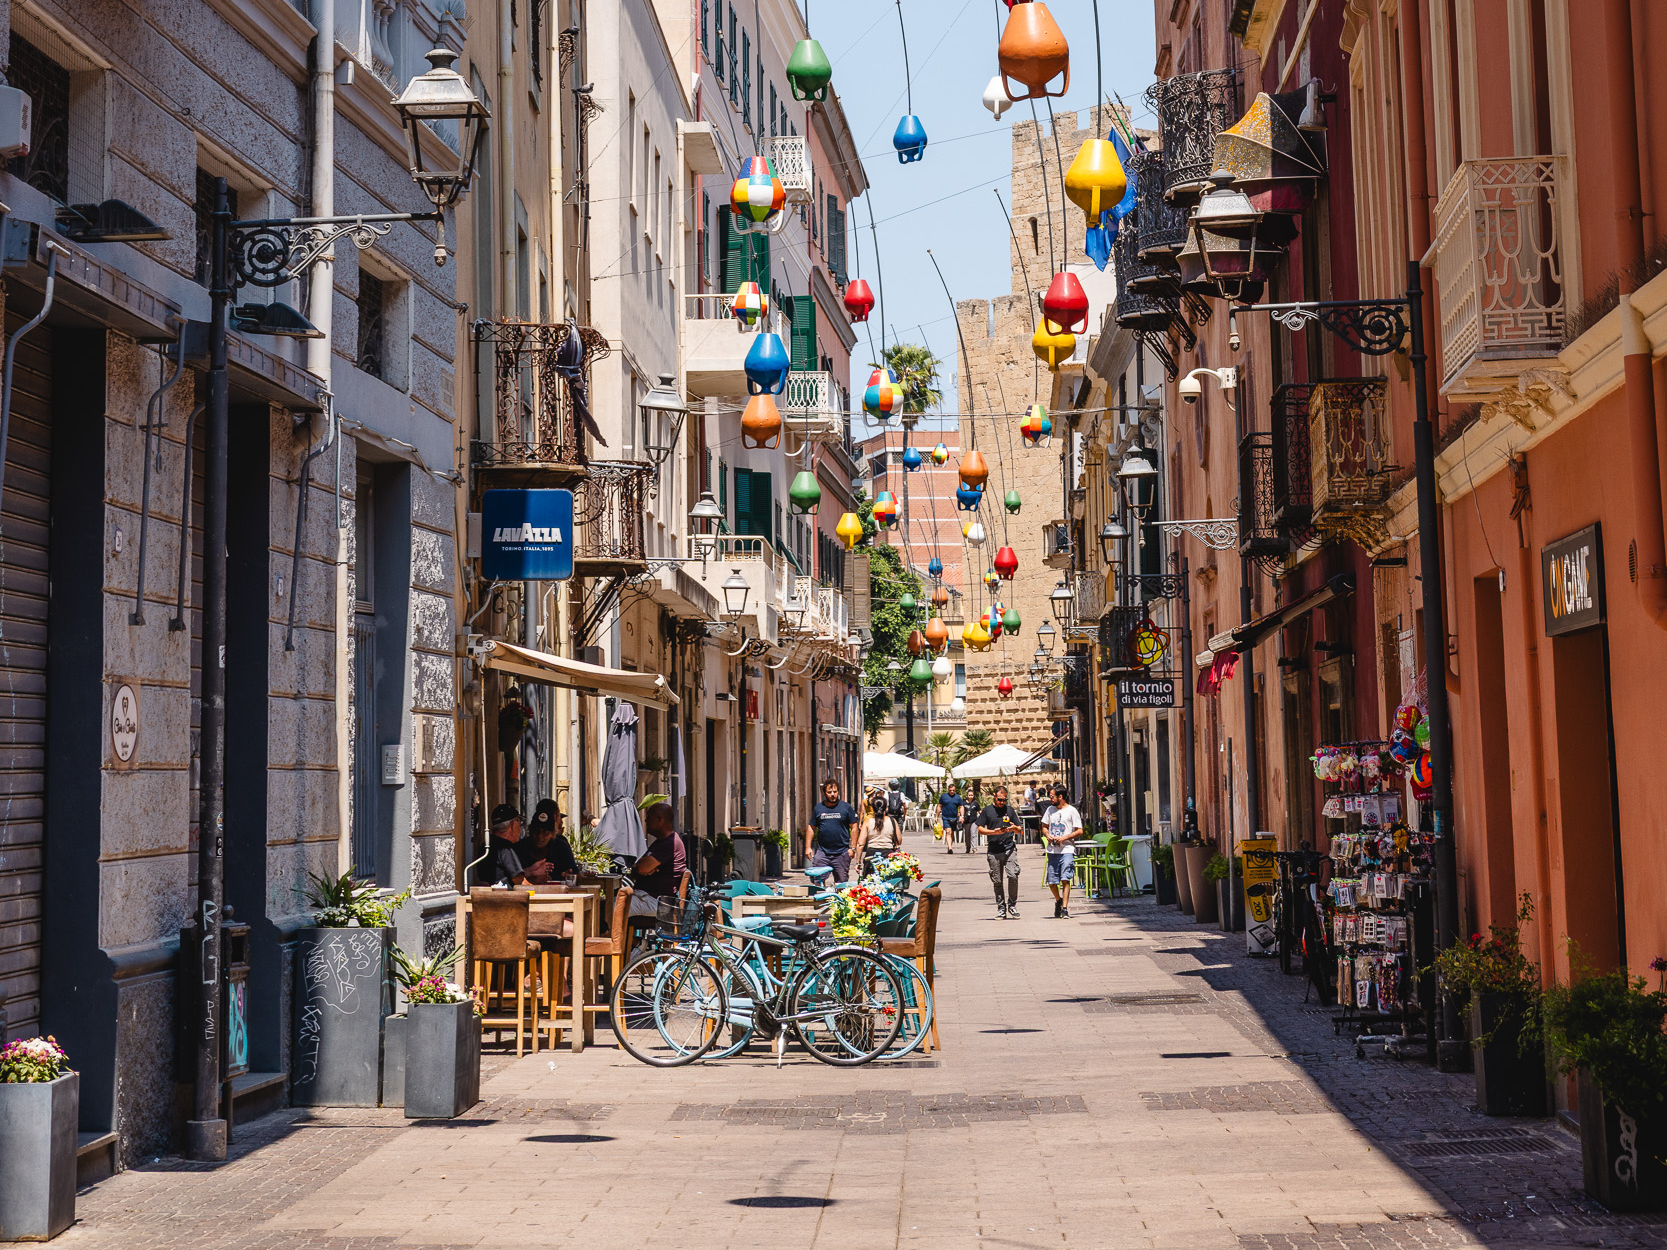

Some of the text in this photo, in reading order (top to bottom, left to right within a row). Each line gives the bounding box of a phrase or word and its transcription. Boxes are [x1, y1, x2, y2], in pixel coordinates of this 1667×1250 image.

[493, 523, 562, 542] LAVAZZA
[1121, 681, 1172, 693] il tornio
[1121, 694, 1172, 705] di via figoli
[1253, 901, 1263, 916] 200
